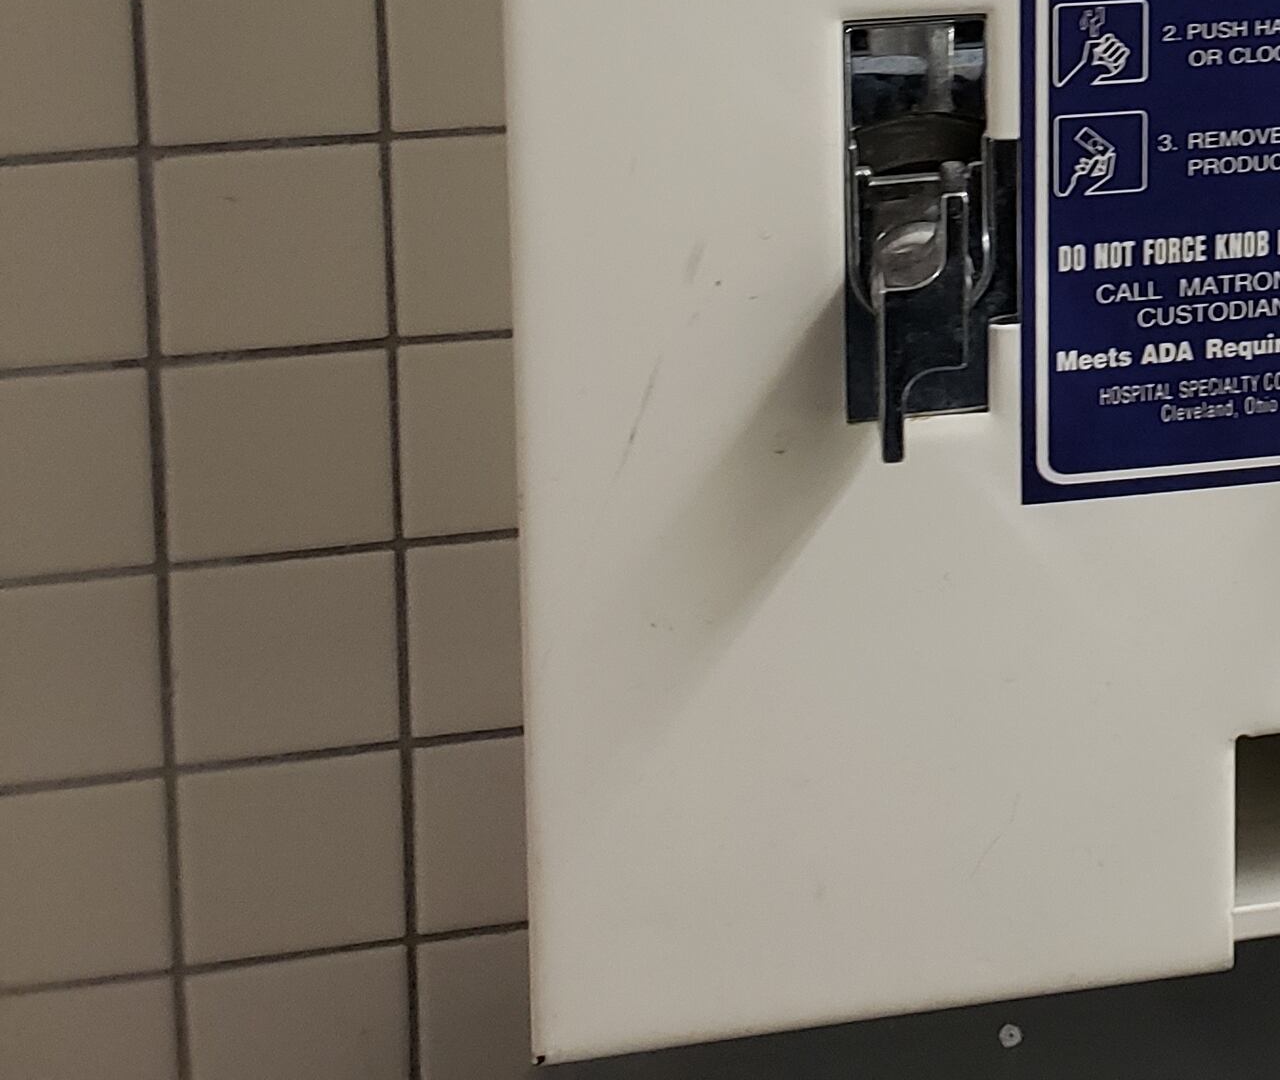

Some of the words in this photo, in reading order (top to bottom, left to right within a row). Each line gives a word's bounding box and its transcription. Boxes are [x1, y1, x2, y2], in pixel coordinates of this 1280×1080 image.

[1162, 25, 1182, 42] 2.
[1186, 21, 1249, 41] PUSH
[1188, 48, 1223, 68] OR
[1157, 134, 1178, 152] 3.
[1058, 243, 1087, 272] DO
[1094, 240, 1136, 270] NOT
[1142, 234, 1208, 266] FORCE
[1214, 229, 1270, 261] KNOB
[1095, 280, 1163, 305] CALL
[1055, 346, 1133, 373] Meets
[1140, 341, 1194, 366] ADA
[1099, 381, 1174, 406] HOSPITAL
[1178, 373, 1261, 400] SPECIALTY
[1243, 394, 1279, 416] Ohio
